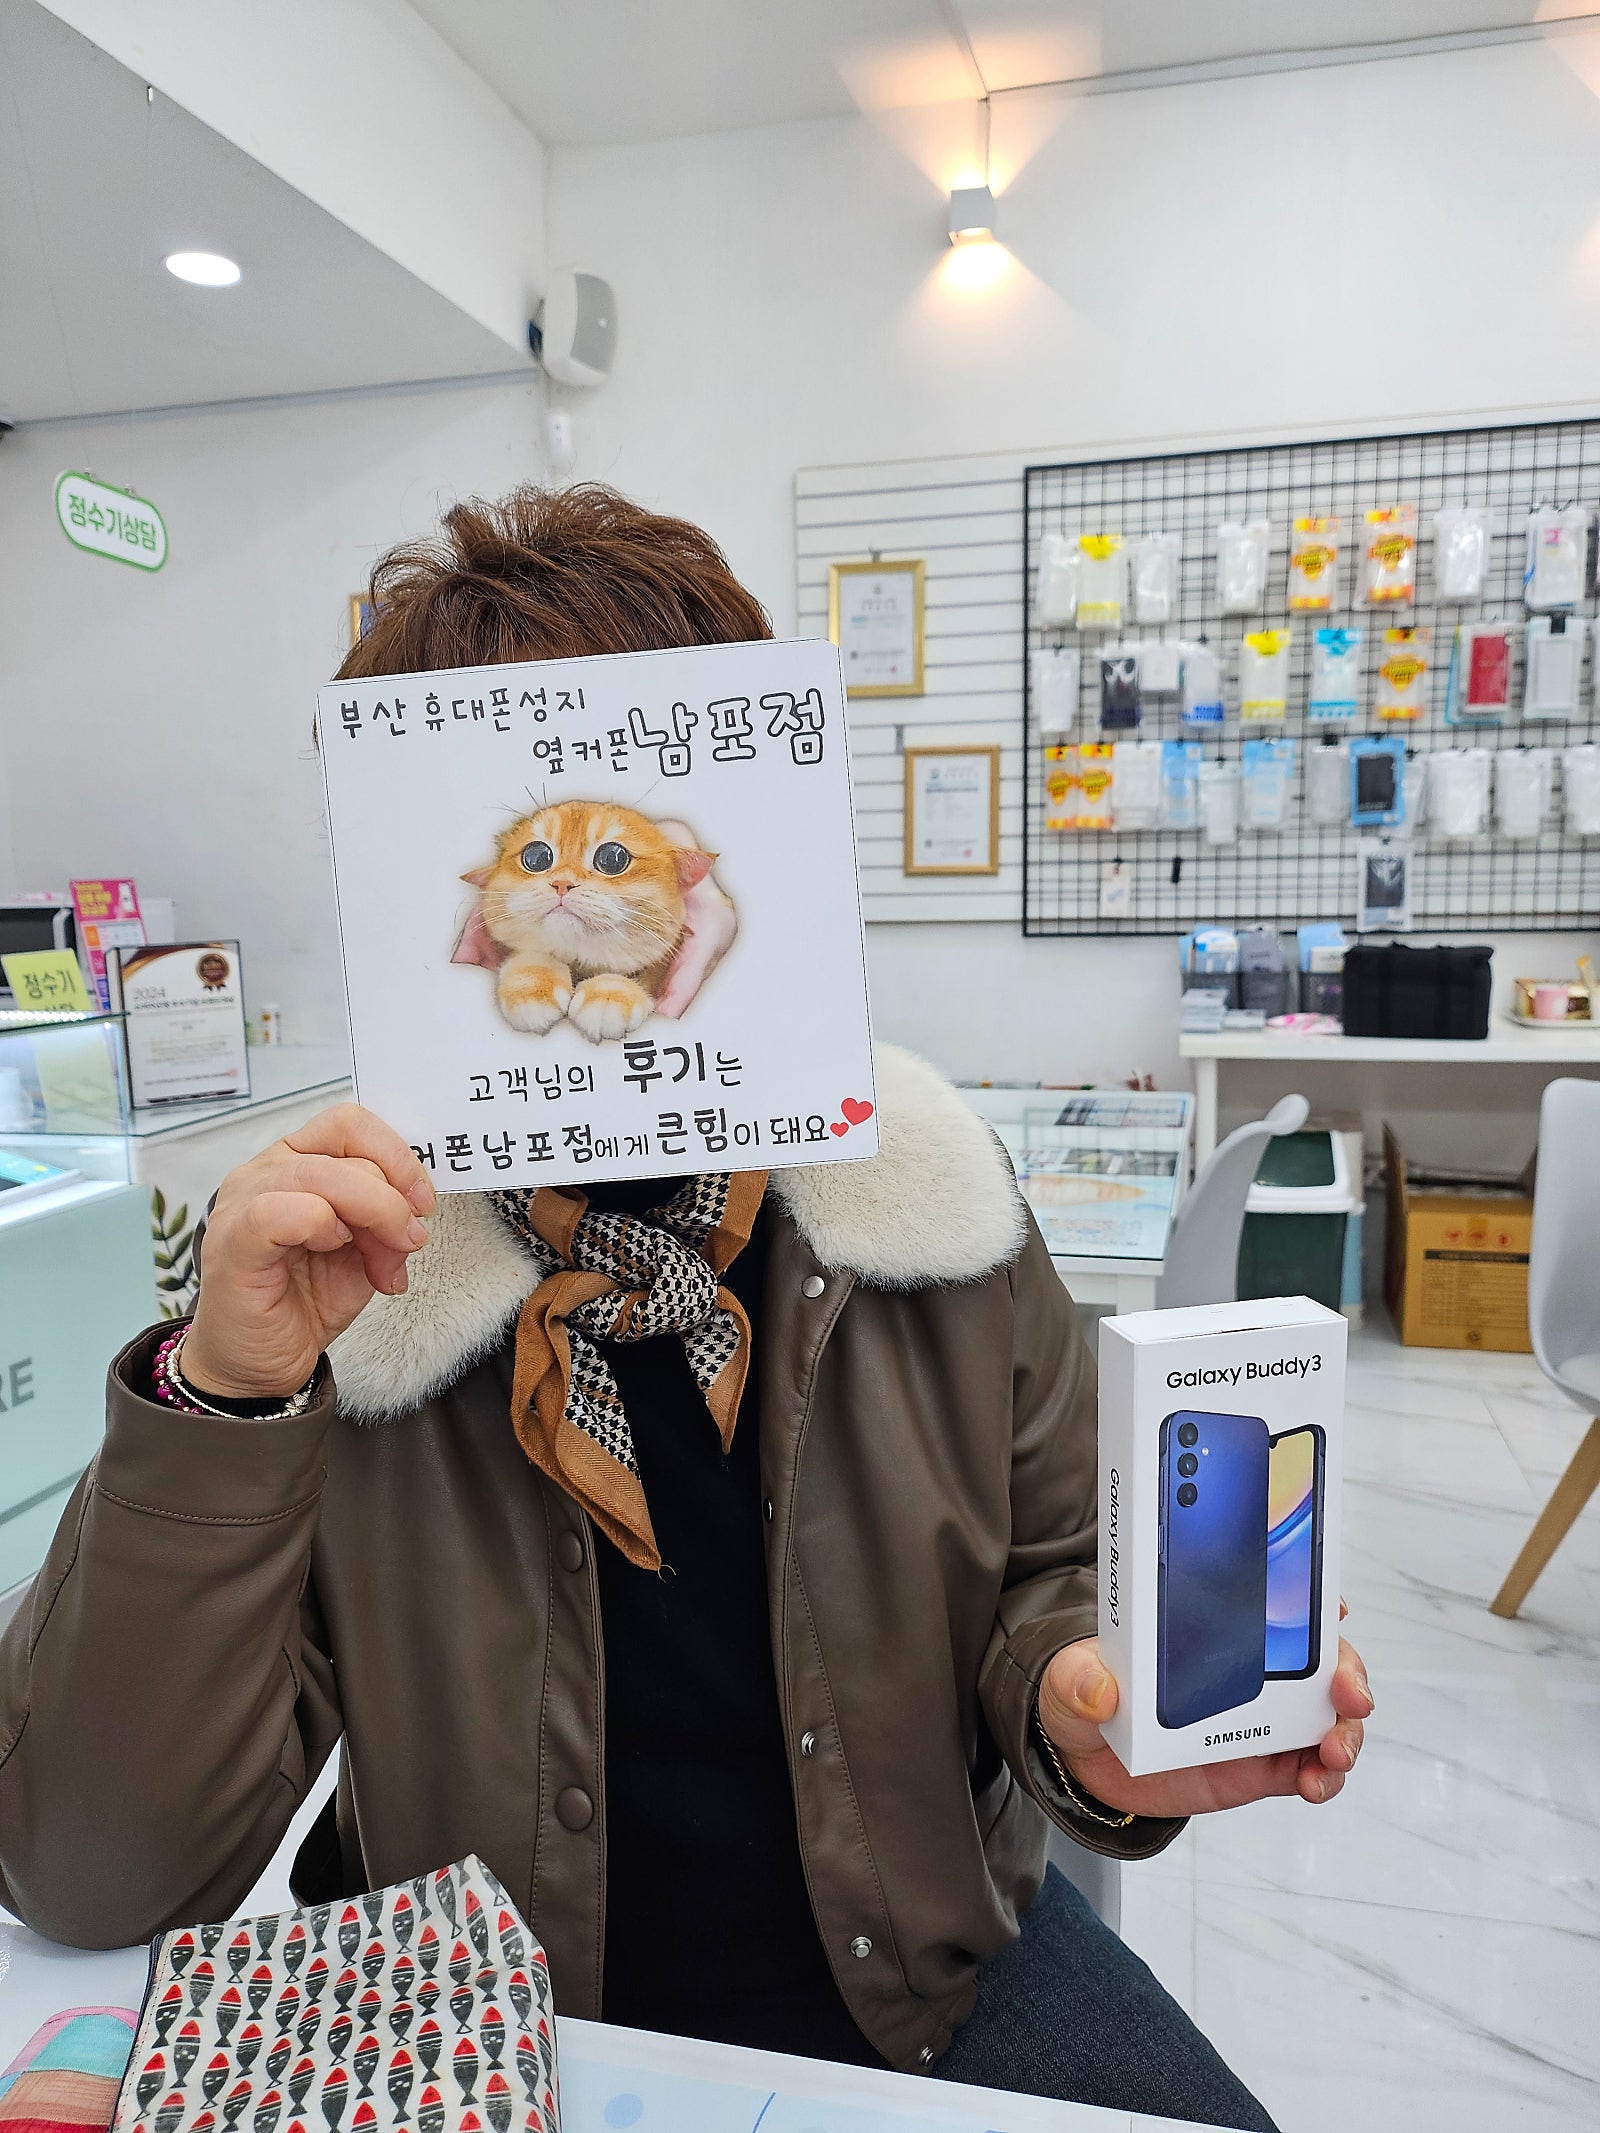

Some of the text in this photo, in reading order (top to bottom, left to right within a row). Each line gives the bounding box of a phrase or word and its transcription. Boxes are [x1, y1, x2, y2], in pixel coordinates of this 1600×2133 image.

[68, 494, 156, 551] 정수기상담
[340, 687, 586, 738] 부산 휴대폰성지
[23, 969, 76, 998] 정수기
[469, 1039, 743, 1102] 고객님의 후기는
[769, 1115, 829, 1145] 돼요
[1166, 1354, 1322, 1389] Galaxy Buddy3
[1107, 1468, 1120, 1628] Galaxy Buddy3
[1204, 1725, 1271, 1747] SAMSUNG
